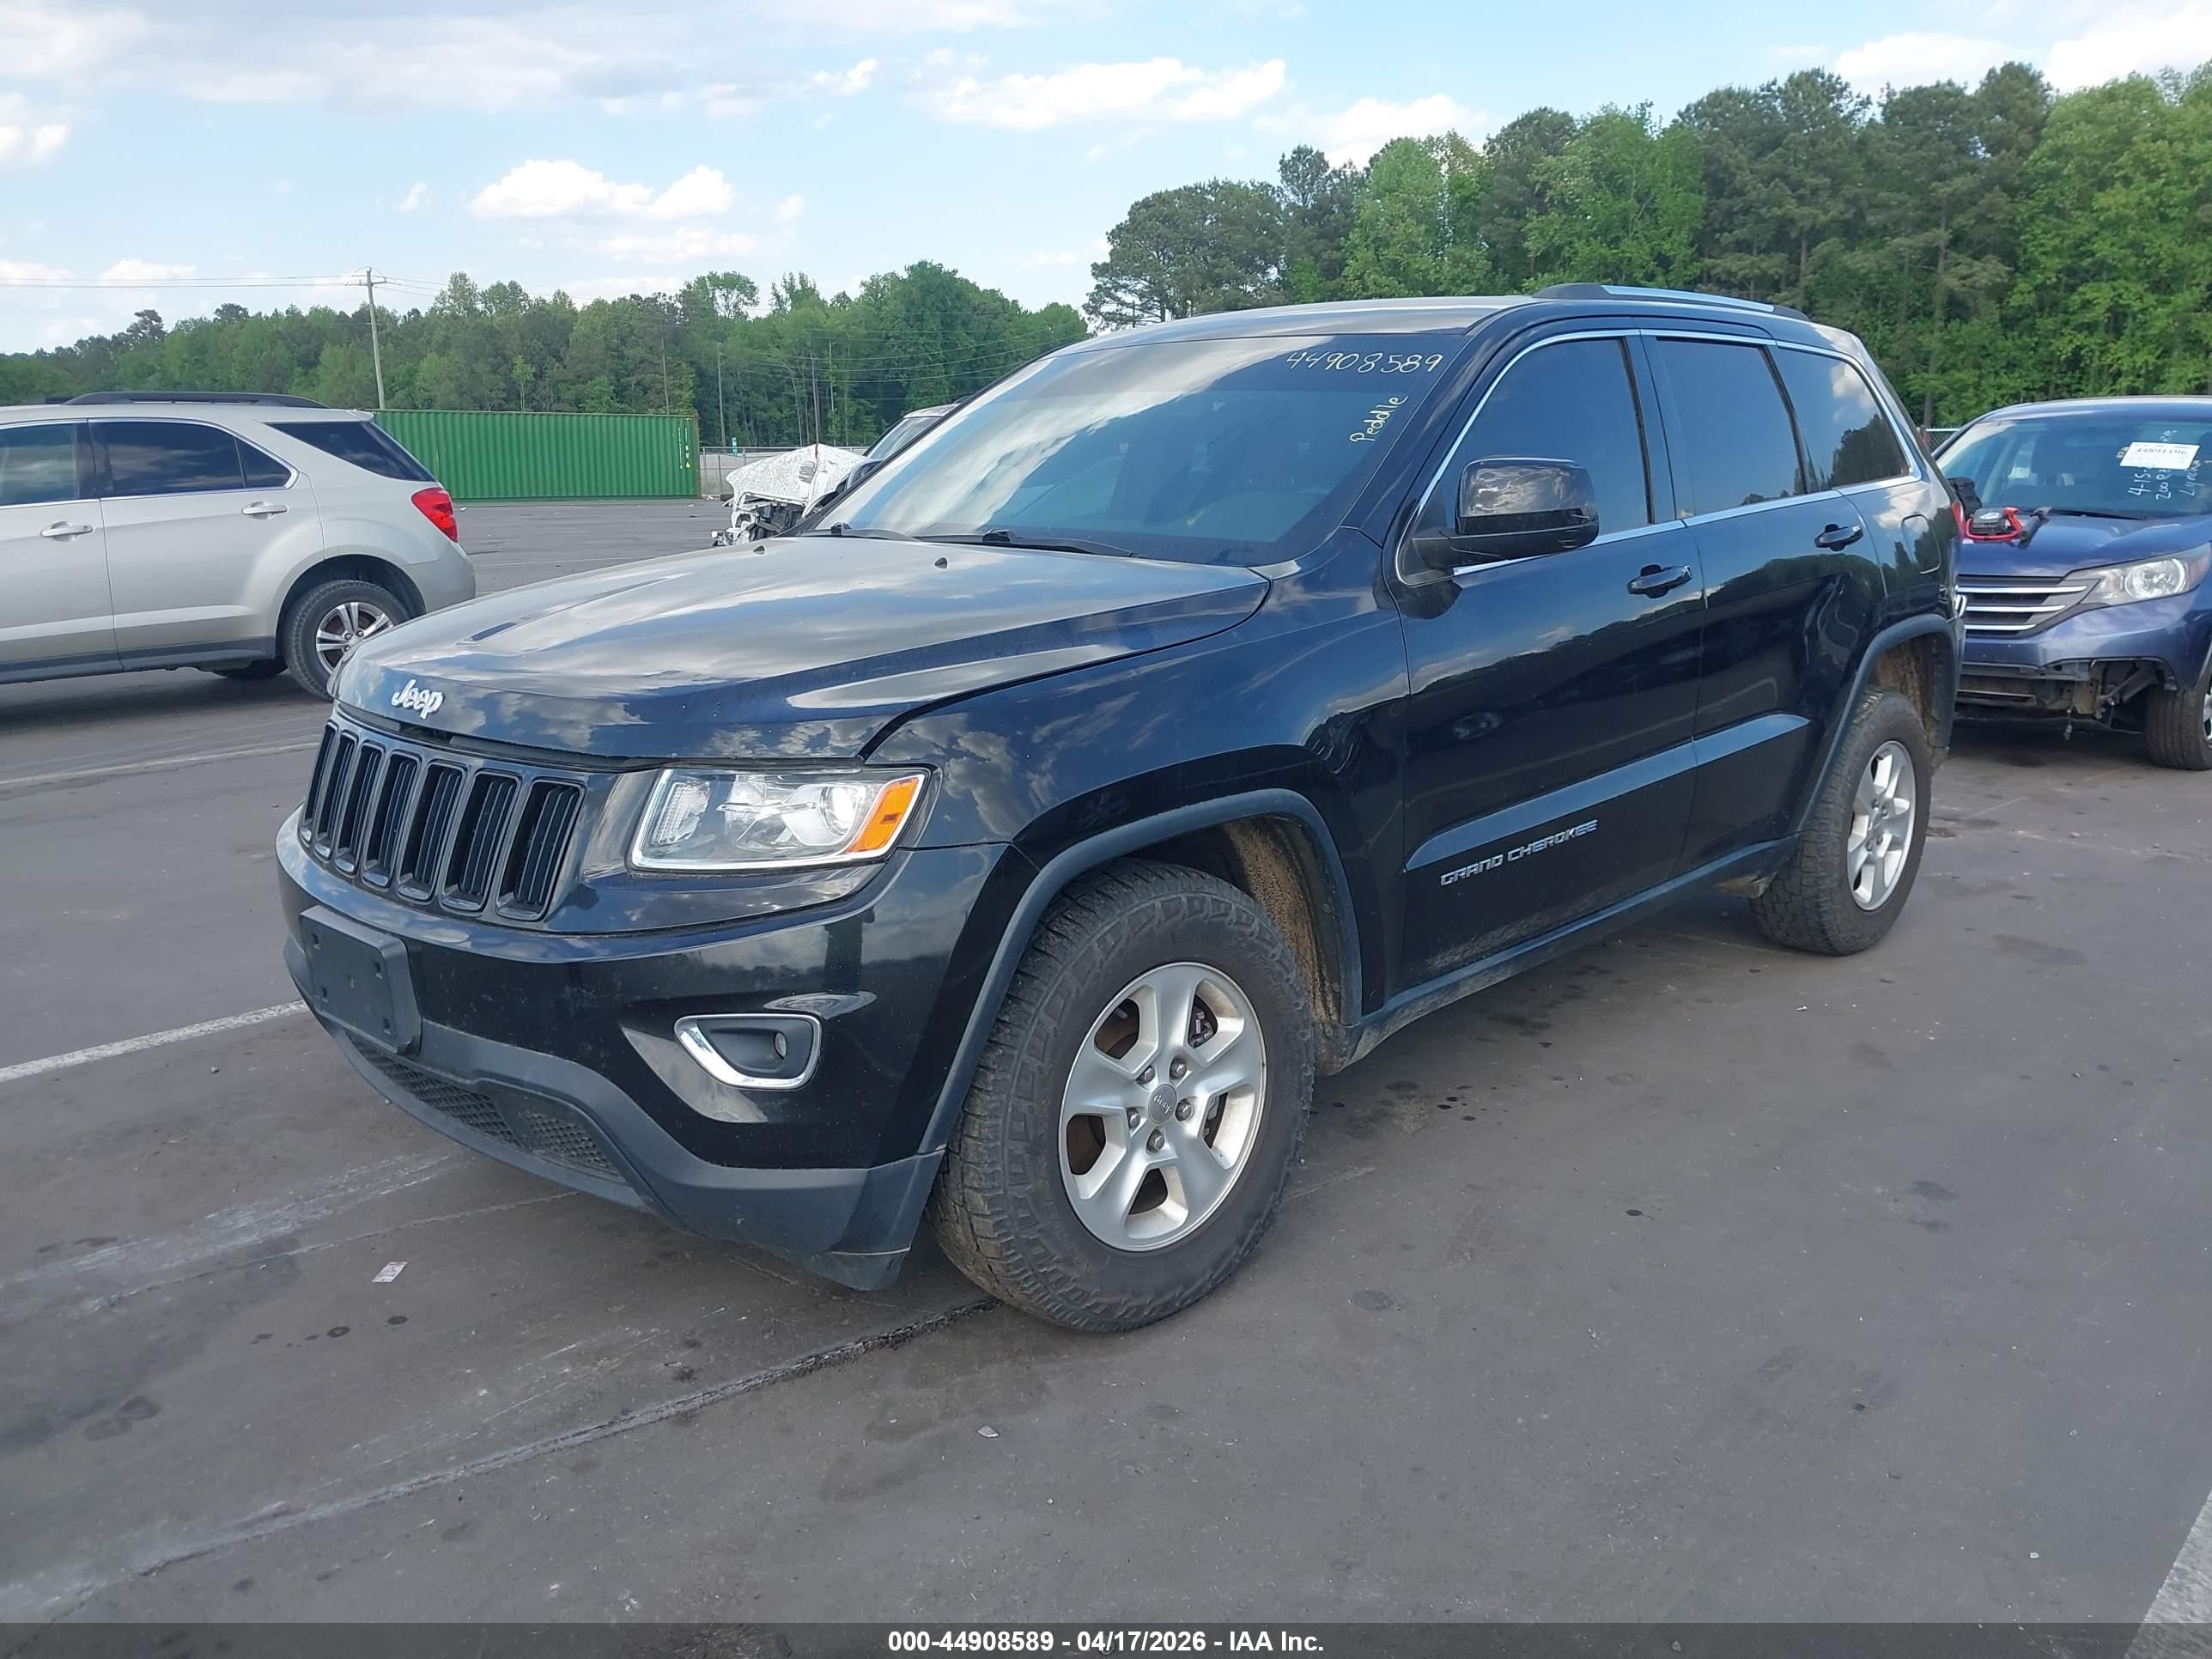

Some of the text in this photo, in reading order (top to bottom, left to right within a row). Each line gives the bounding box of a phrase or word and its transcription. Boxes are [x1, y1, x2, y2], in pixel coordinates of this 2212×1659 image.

[1285, 351, 1444, 374] 44908589
[1349, 395, 1409, 442] Peddle
[391, 678, 445, 720] Jeep
[1440, 818, 1599, 886] GRAND CHEROKEE
